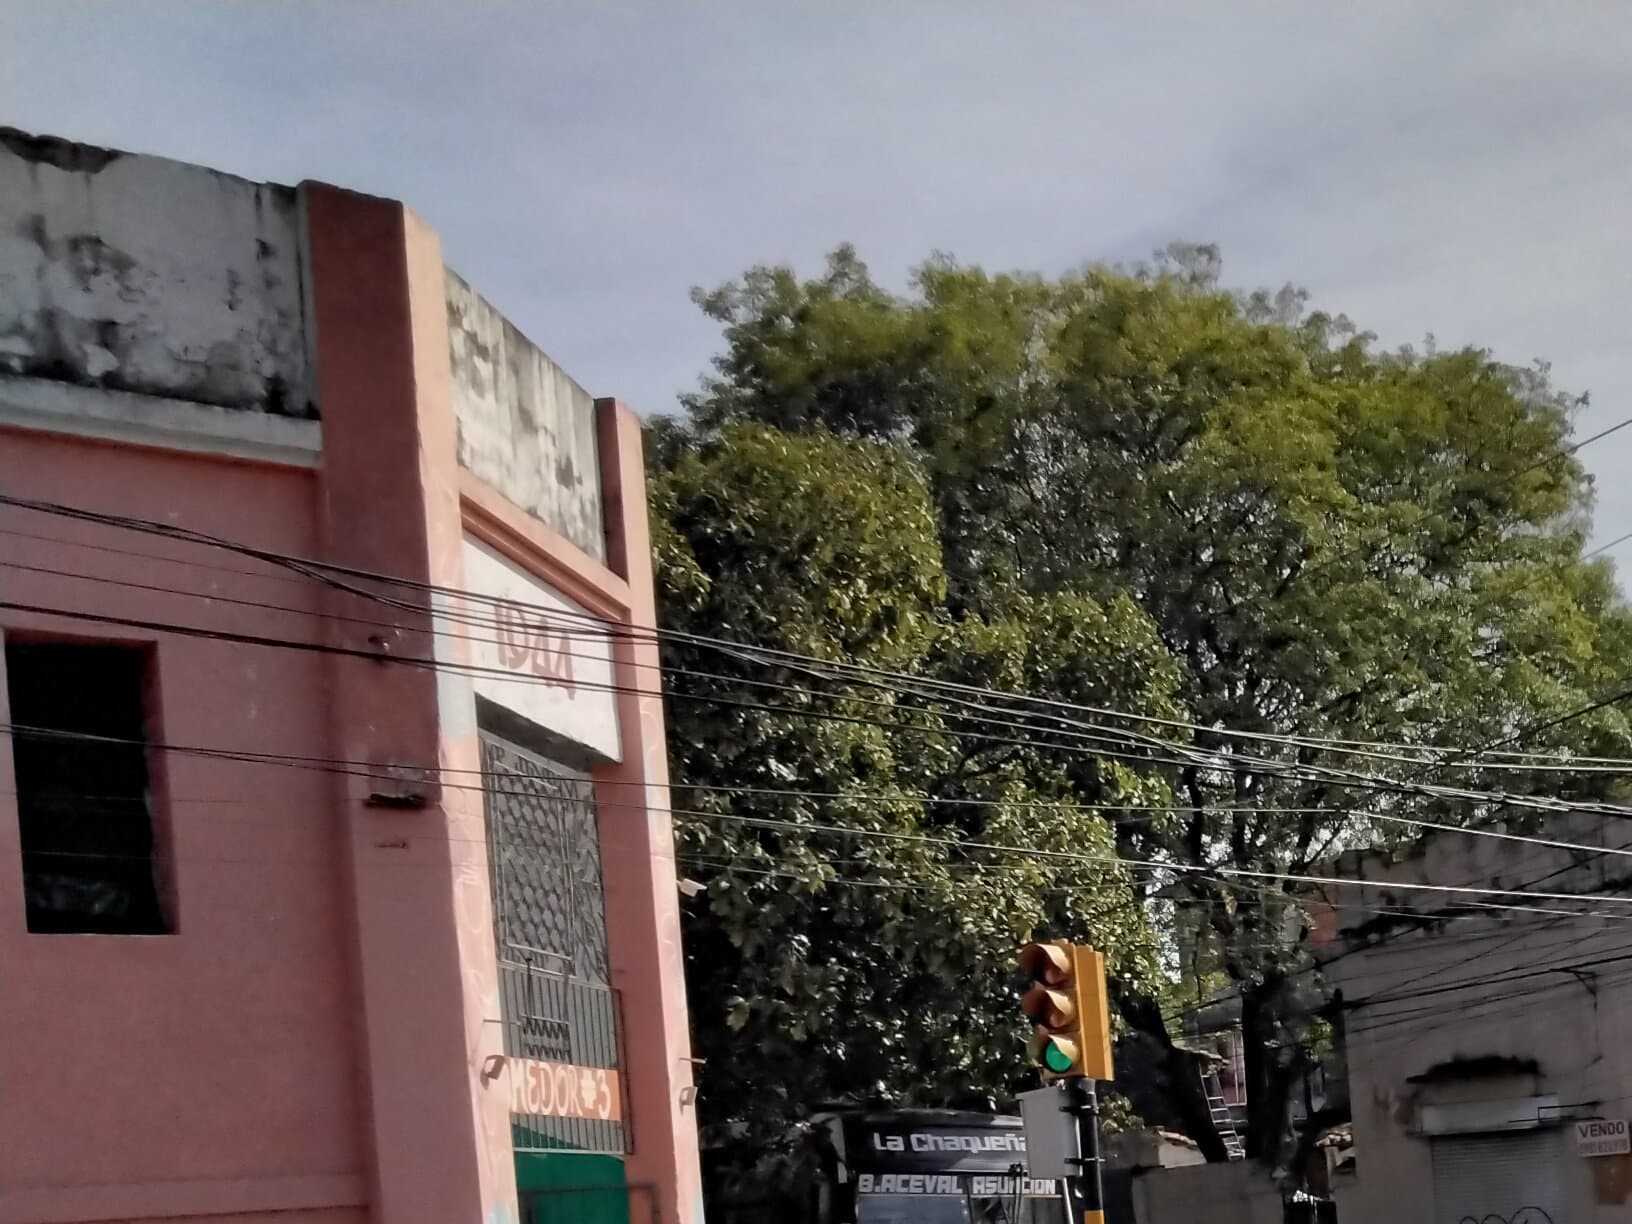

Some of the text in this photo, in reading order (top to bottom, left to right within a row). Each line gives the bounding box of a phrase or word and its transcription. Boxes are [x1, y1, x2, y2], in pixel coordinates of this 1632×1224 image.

[1578, 1121, 1625, 1138] VENDO
[873, 1132, 905, 1151] La
[858, 1173, 964, 1195] B.ACEVAL
